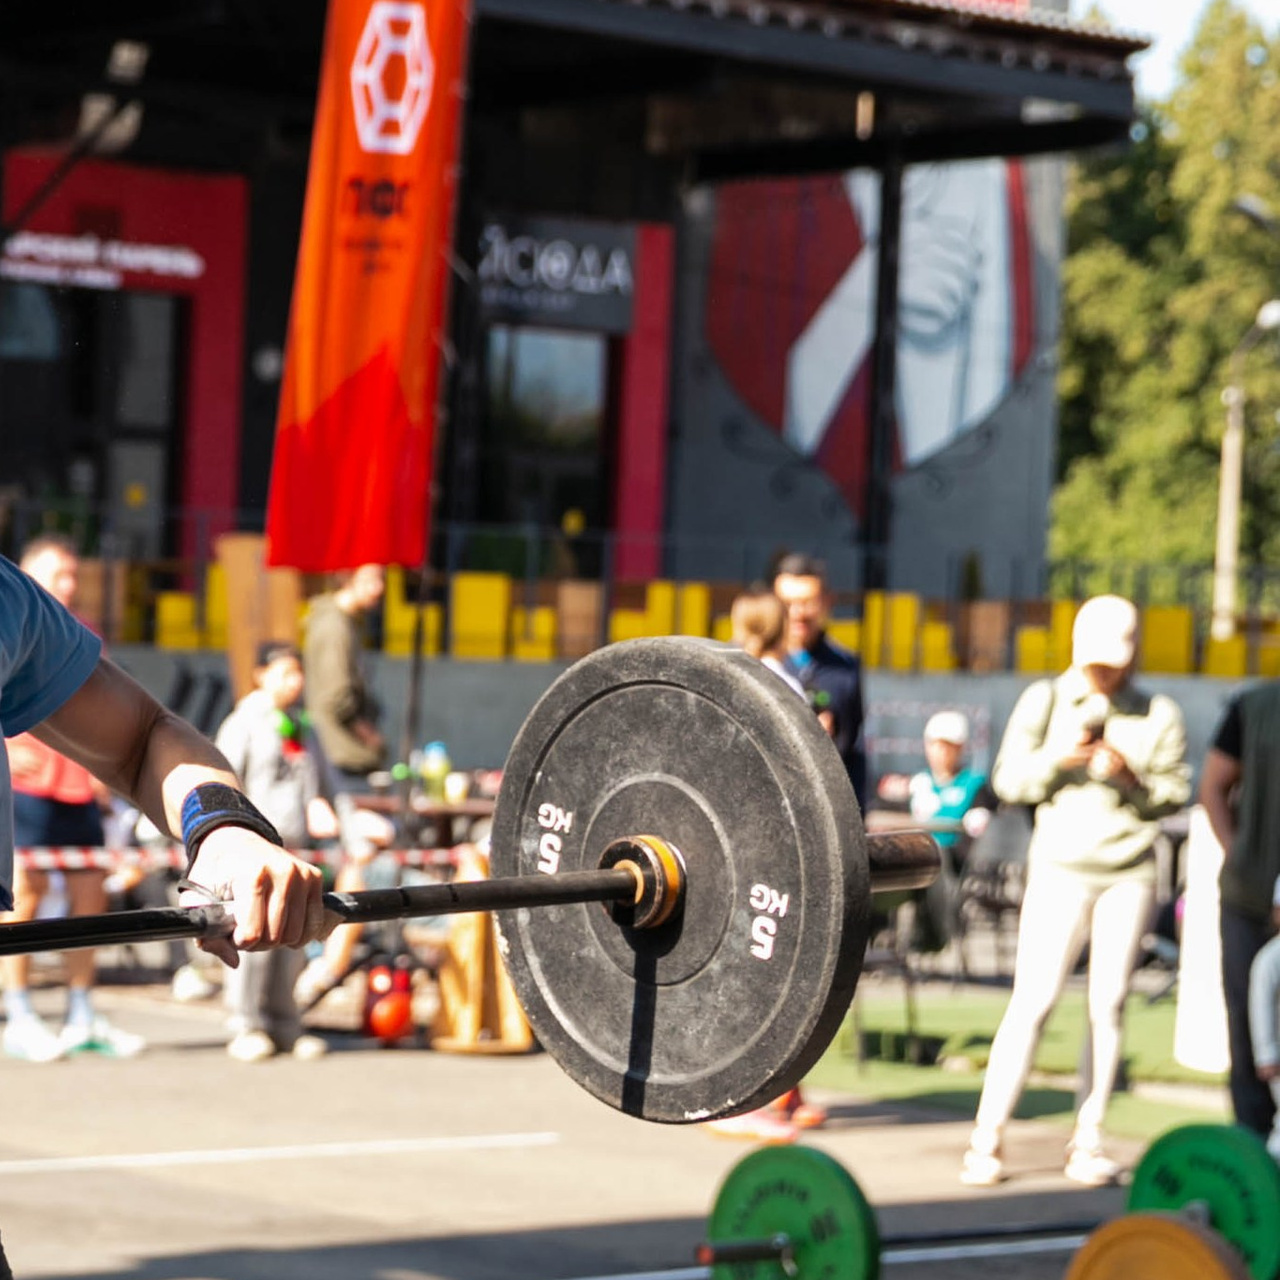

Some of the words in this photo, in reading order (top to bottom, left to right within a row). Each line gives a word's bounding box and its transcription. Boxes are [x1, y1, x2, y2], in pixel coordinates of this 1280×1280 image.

[537, 802, 574, 834] KG
[537, 833, 563, 876] 5
[749, 883, 790, 918] KG
[750, 915, 778, 961] 5
